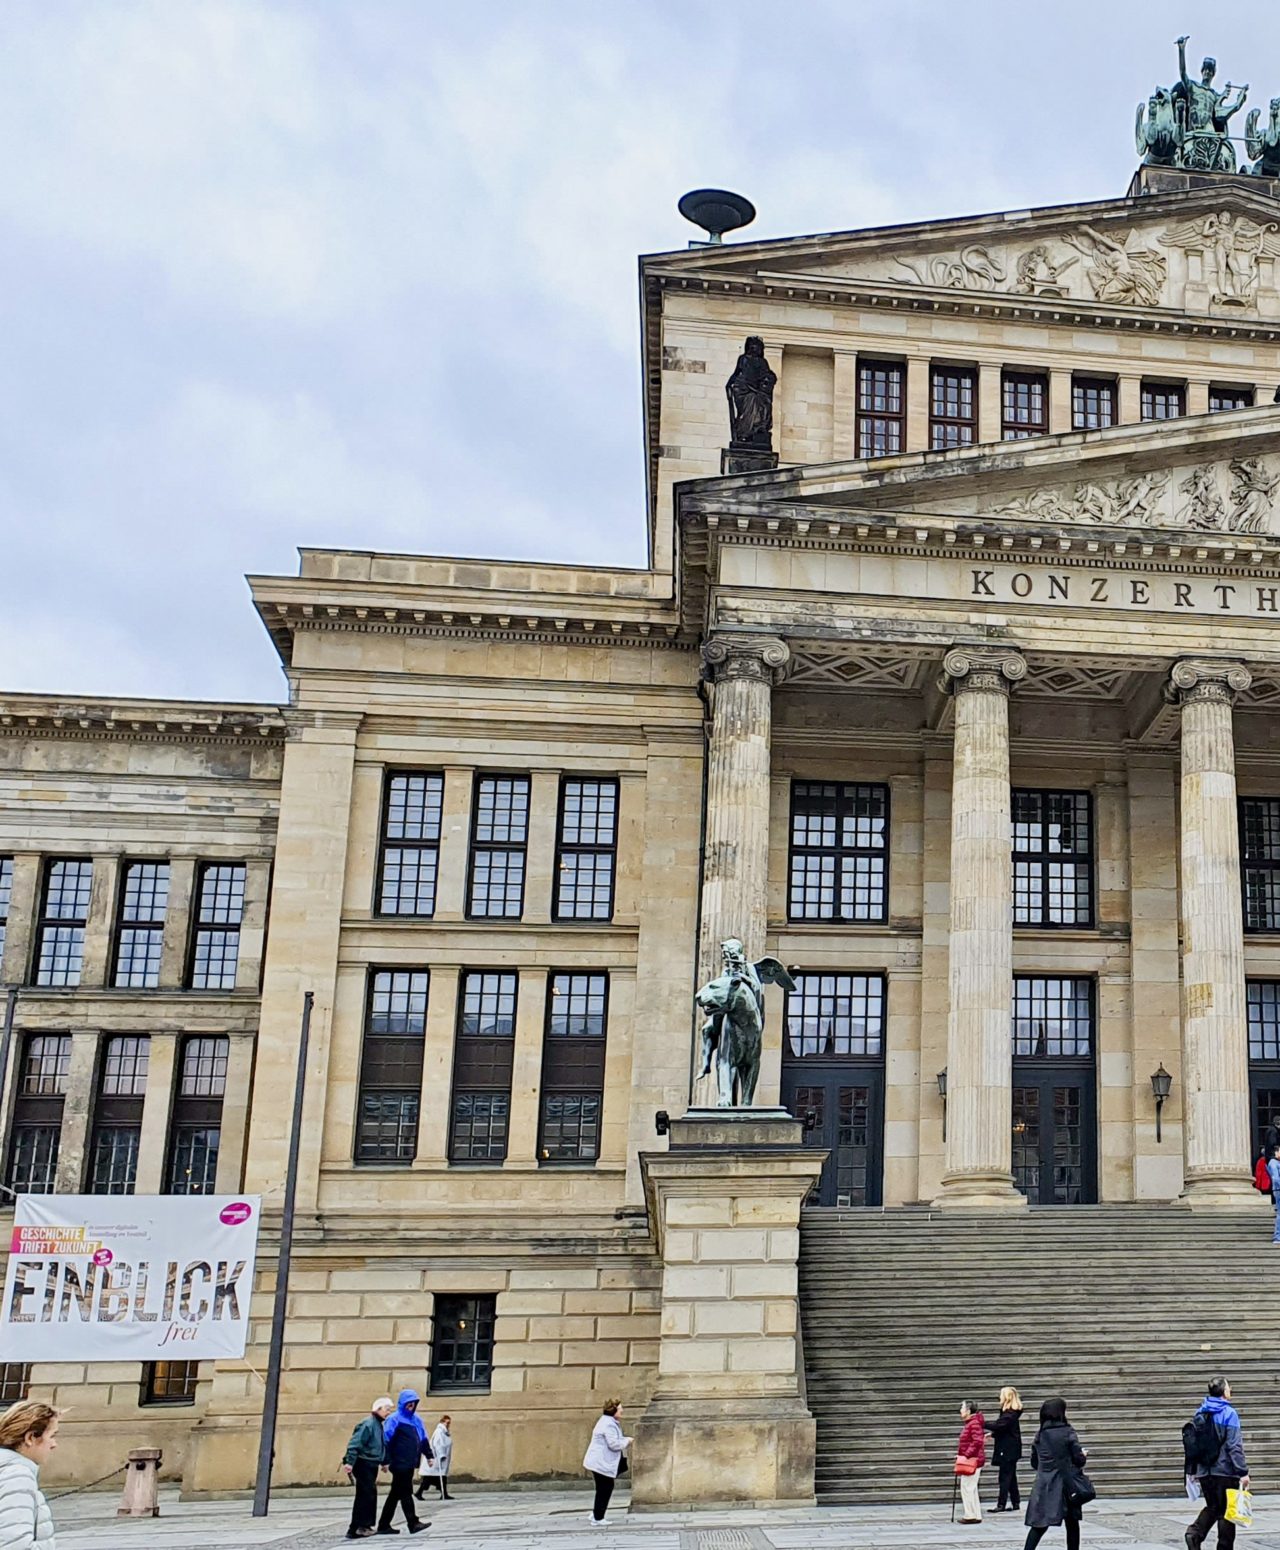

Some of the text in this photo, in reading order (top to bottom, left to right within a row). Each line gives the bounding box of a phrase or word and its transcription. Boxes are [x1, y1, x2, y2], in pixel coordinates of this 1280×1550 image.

[20, 1227, 81, 1240] GESCHICHTE
[19, 1240, 99, 1253] TRIFFT ZUKUNFT
[9, 1260, 247, 1322] EINBLICK
[157, 1321, 200, 1347] frei
